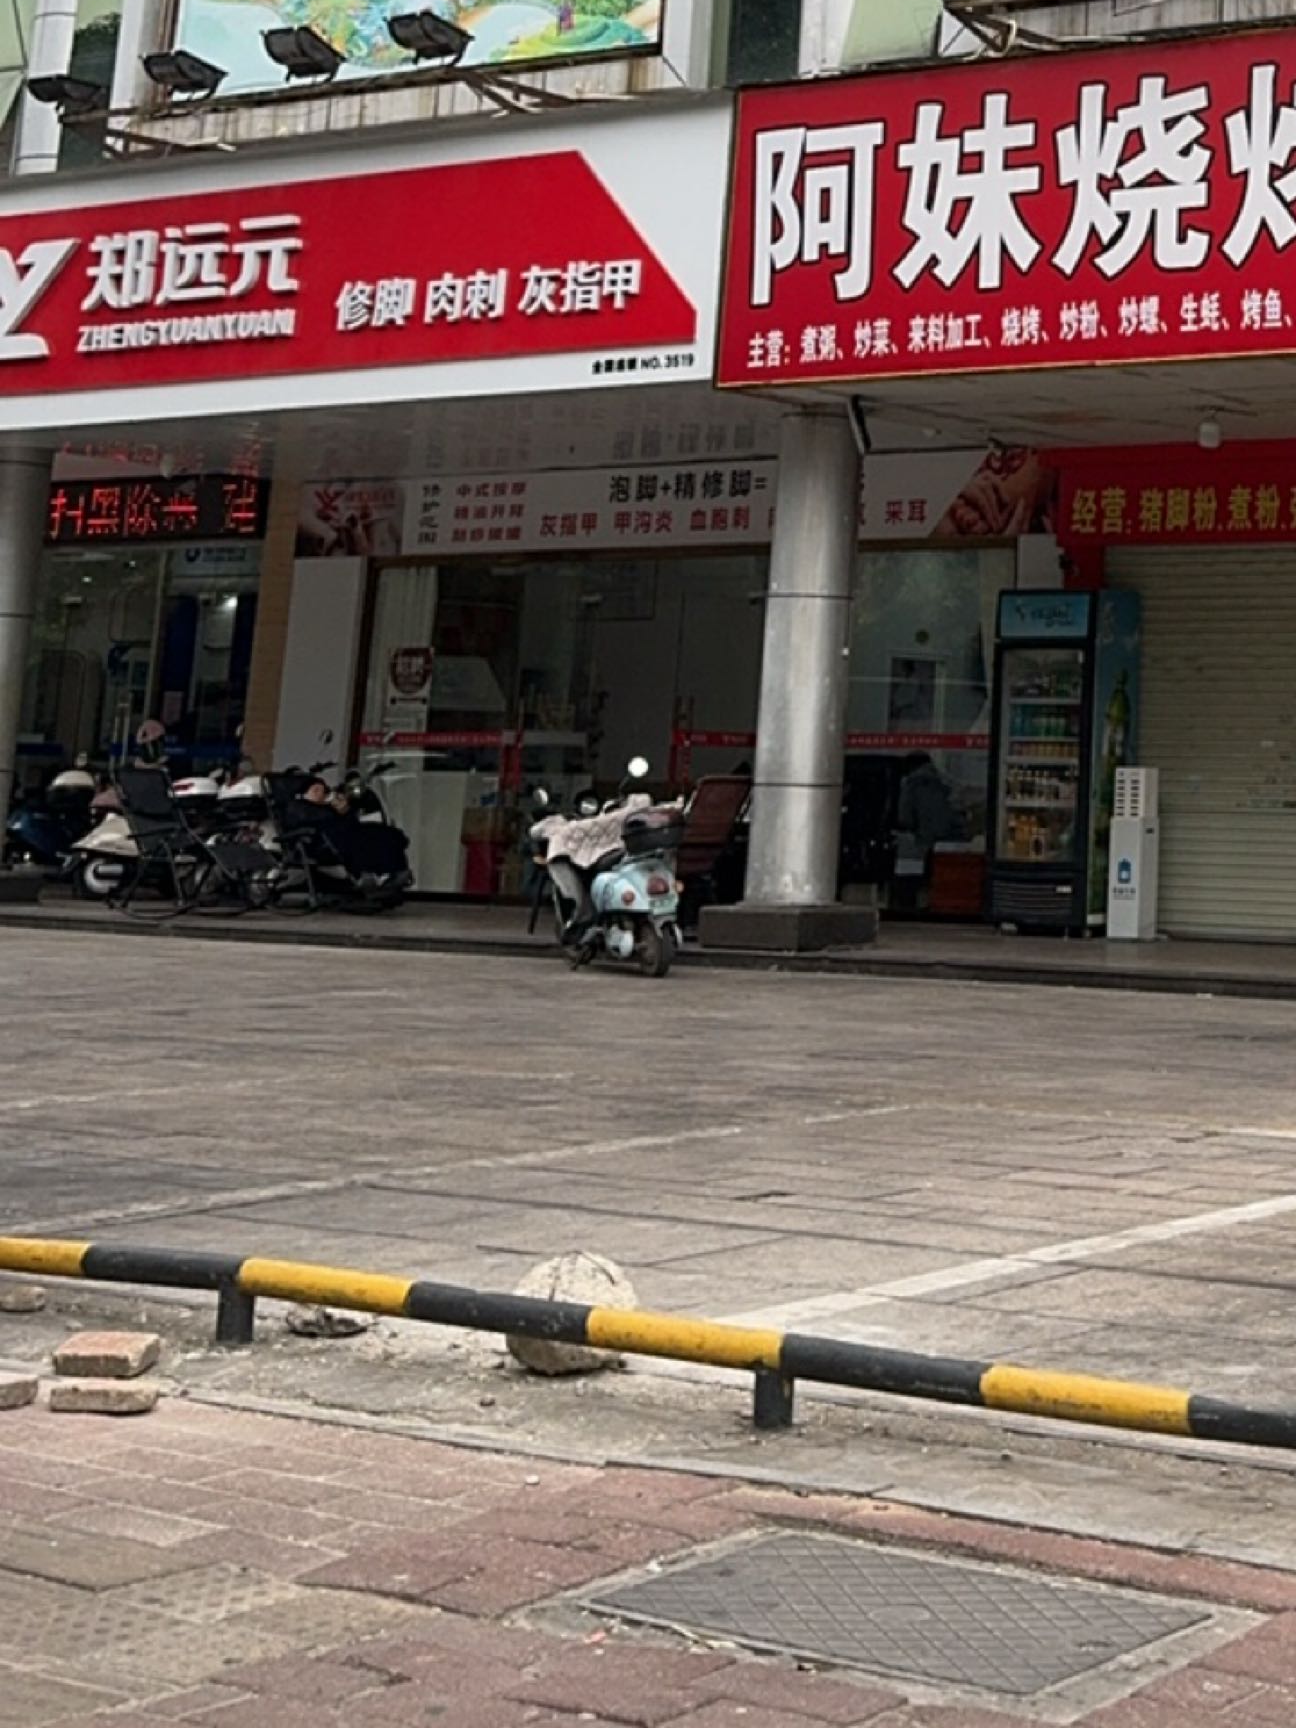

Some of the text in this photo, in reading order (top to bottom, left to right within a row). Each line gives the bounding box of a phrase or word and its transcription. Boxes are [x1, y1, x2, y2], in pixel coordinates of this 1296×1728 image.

[80, 212, 304, 313] 郑远元
[336, 257, 644, 332] 修脚 肉刺 灰指甲
[74, 307, 297, 355] ZHENGYUANYUAN
[538, 512, 599, 538] 灰指甲
[613, 509, 674, 536] 甲沟炎
[884, 498, 930, 524] 采耳
